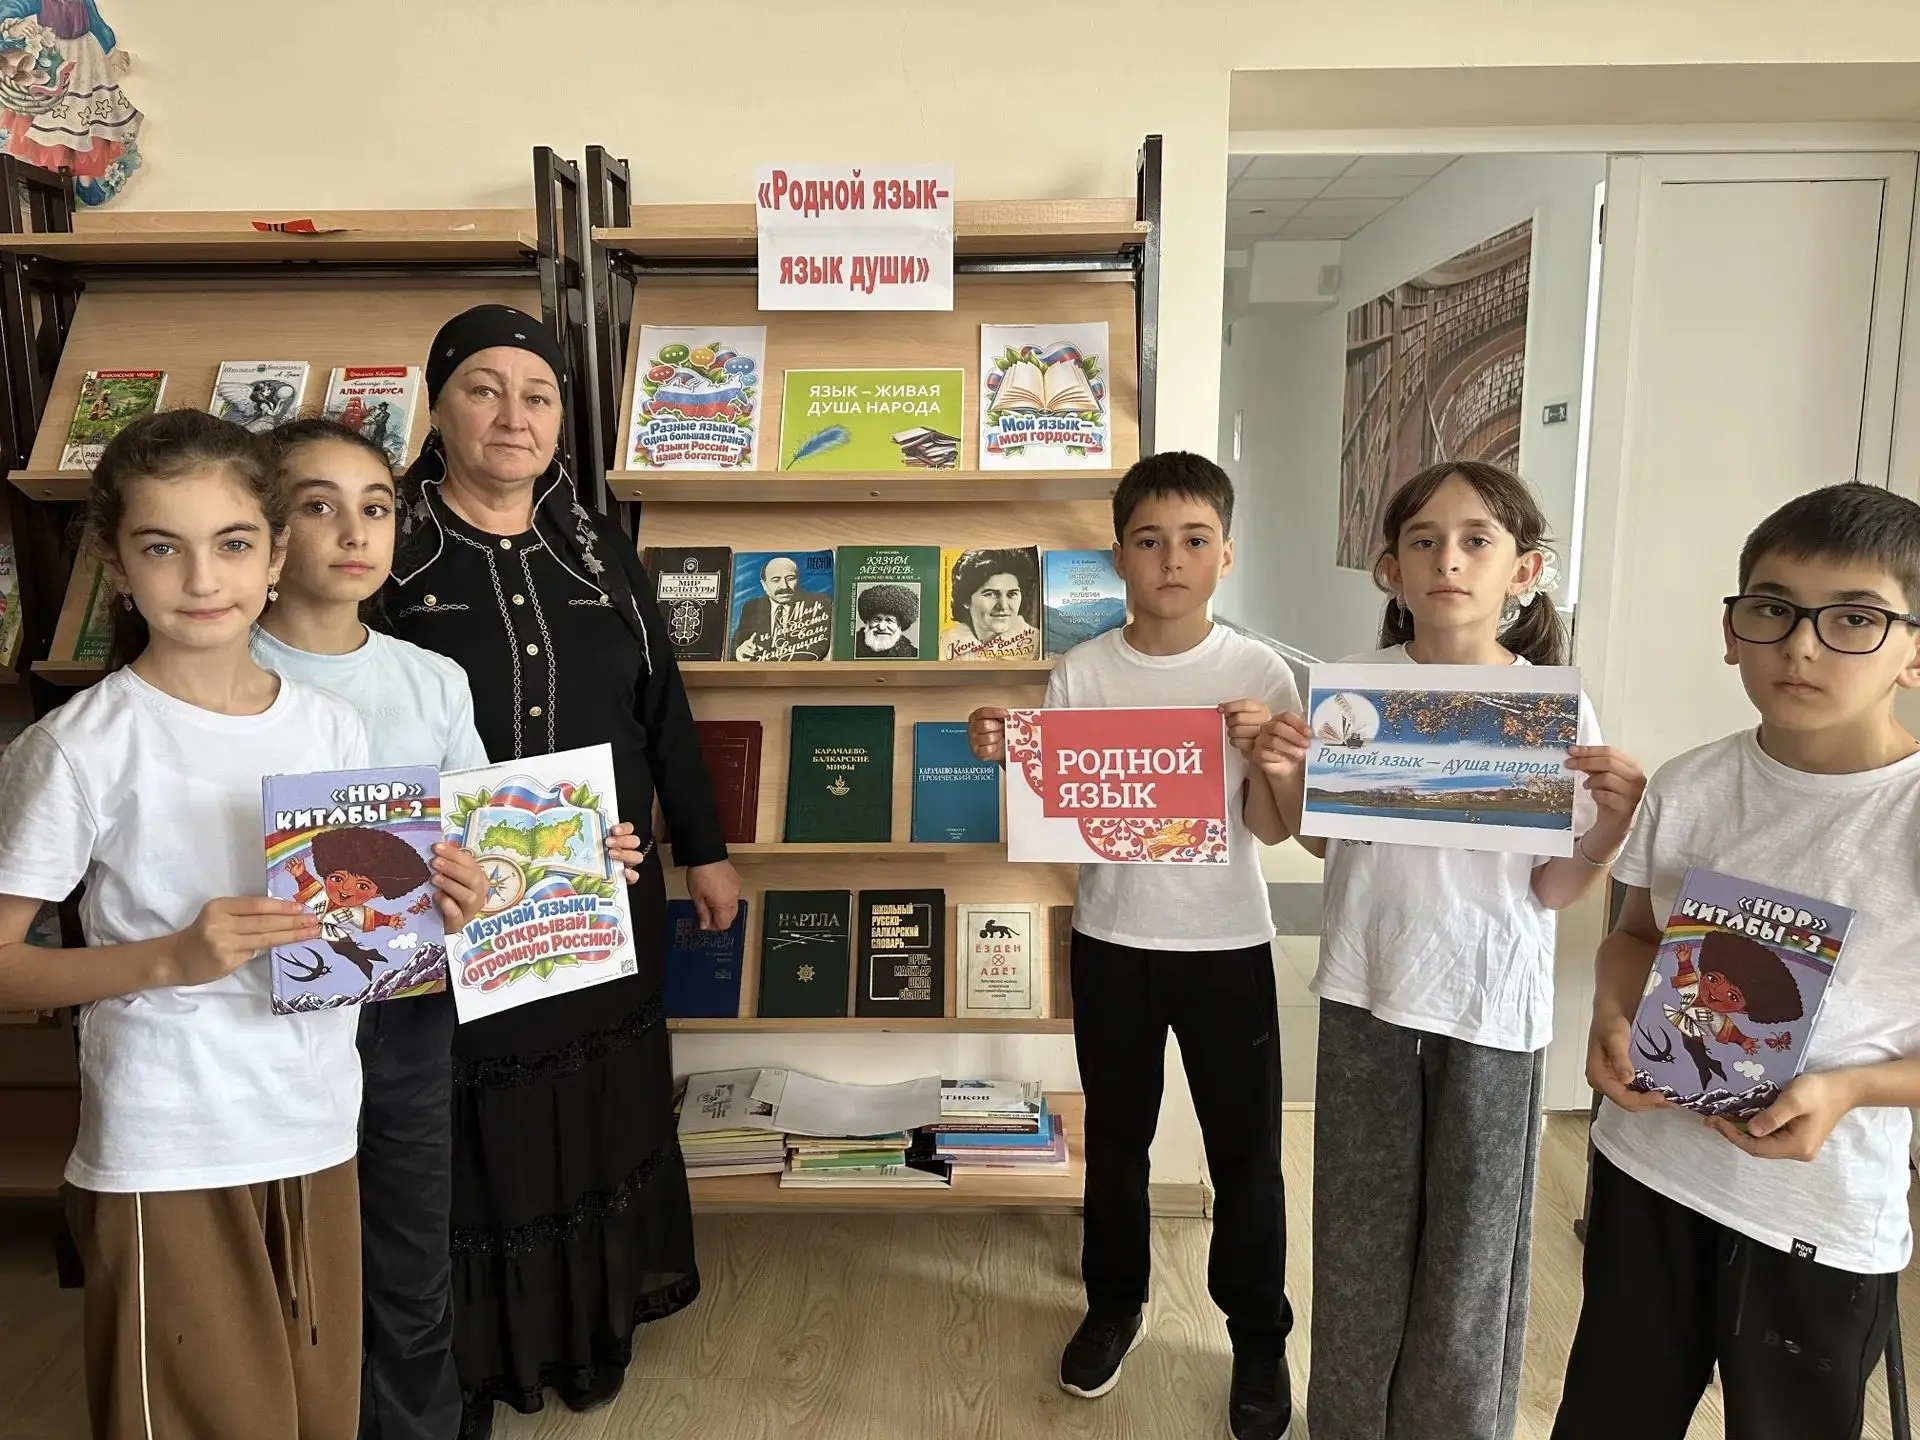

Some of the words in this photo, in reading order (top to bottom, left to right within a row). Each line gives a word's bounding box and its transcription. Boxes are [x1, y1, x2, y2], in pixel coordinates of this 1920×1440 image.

[758, 169, 865, 218] «Родной
[780, 256, 843, 284] язык
[850, 256, 930, 294] души»
[339, 388, 366, 396] АЛЫЕ
[368, 387, 404, 395] ПАРУСА
[809, 385, 858, 398] ЯЗЫК
[874, 385, 941, 397] ЖИВАЯ
[807, 401, 861, 416] ДУША
[866, 401, 941, 416] НАРОДА
[650, 422, 697, 435] Разные
[699, 422, 735, 434] языки
[1002, 416, 1035, 433] Мой
[643, 434, 668, 446] одна
[669, 431, 710, 441] большая
[712, 434, 746, 446] страна.
[998, 431, 1028, 445] моя
[1030, 431, 1096, 445] гордость.
[656, 442, 690, 453] Языки
[691, 441, 729, 452] России
[656, 451, 683, 462] наше
[684, 450, 738, 463] богатство!
[807, 557, 832, 570] ПЕСНИ
[866, 555, 910, 566] КЯЗИМ
[780, 600, 824, 625] Мир
[771, 613, 829, 648] радость
[756, 634, 828, 661] живущие
[1056, 741, 1204, 780] РОДНОЙ
[1316, 747, 1377, 768] Родной
[1380, 756, 1424, 769] язык
[1441, 758, 1490, 775] душа
[1493, 760, 1560, 778] народа
[330, 781, 423, 804] «НЮР»
[1058, 782, 1157, 809] ЯЗЫК
[275, 803, 387, 831] КИТАБЫ
[872, 902, 914, 915] ШКОЛЬНЫЙ
[1737, 896, 1829, 931] «НЮР»
[465, 902, 535, 945] Изучай
[539, 896, 597, 918] языки
[779, 913, 840, 927] НАРТЛА
[872, 916, 902, 926] РУССКО-
[1681, 897, 1786, 944] КИТАБЫ
[493, 912, 588, 951] открывай
[871, 925, 919, 937] БАЛКАРСКИЙ
[871, 938, 905, 949] СЛОВАРЬ
[467, 937, 550, 983] огромную
[552, 931, 618, 953] Россию!
[894, 965, 931, 976] МАЛКЪАР
[981, 968, 1017, 976] АДЕТ
[908, 977, 931, 988] ШКОЛ
[1795, 1242, 1813, 1254] MOVE
